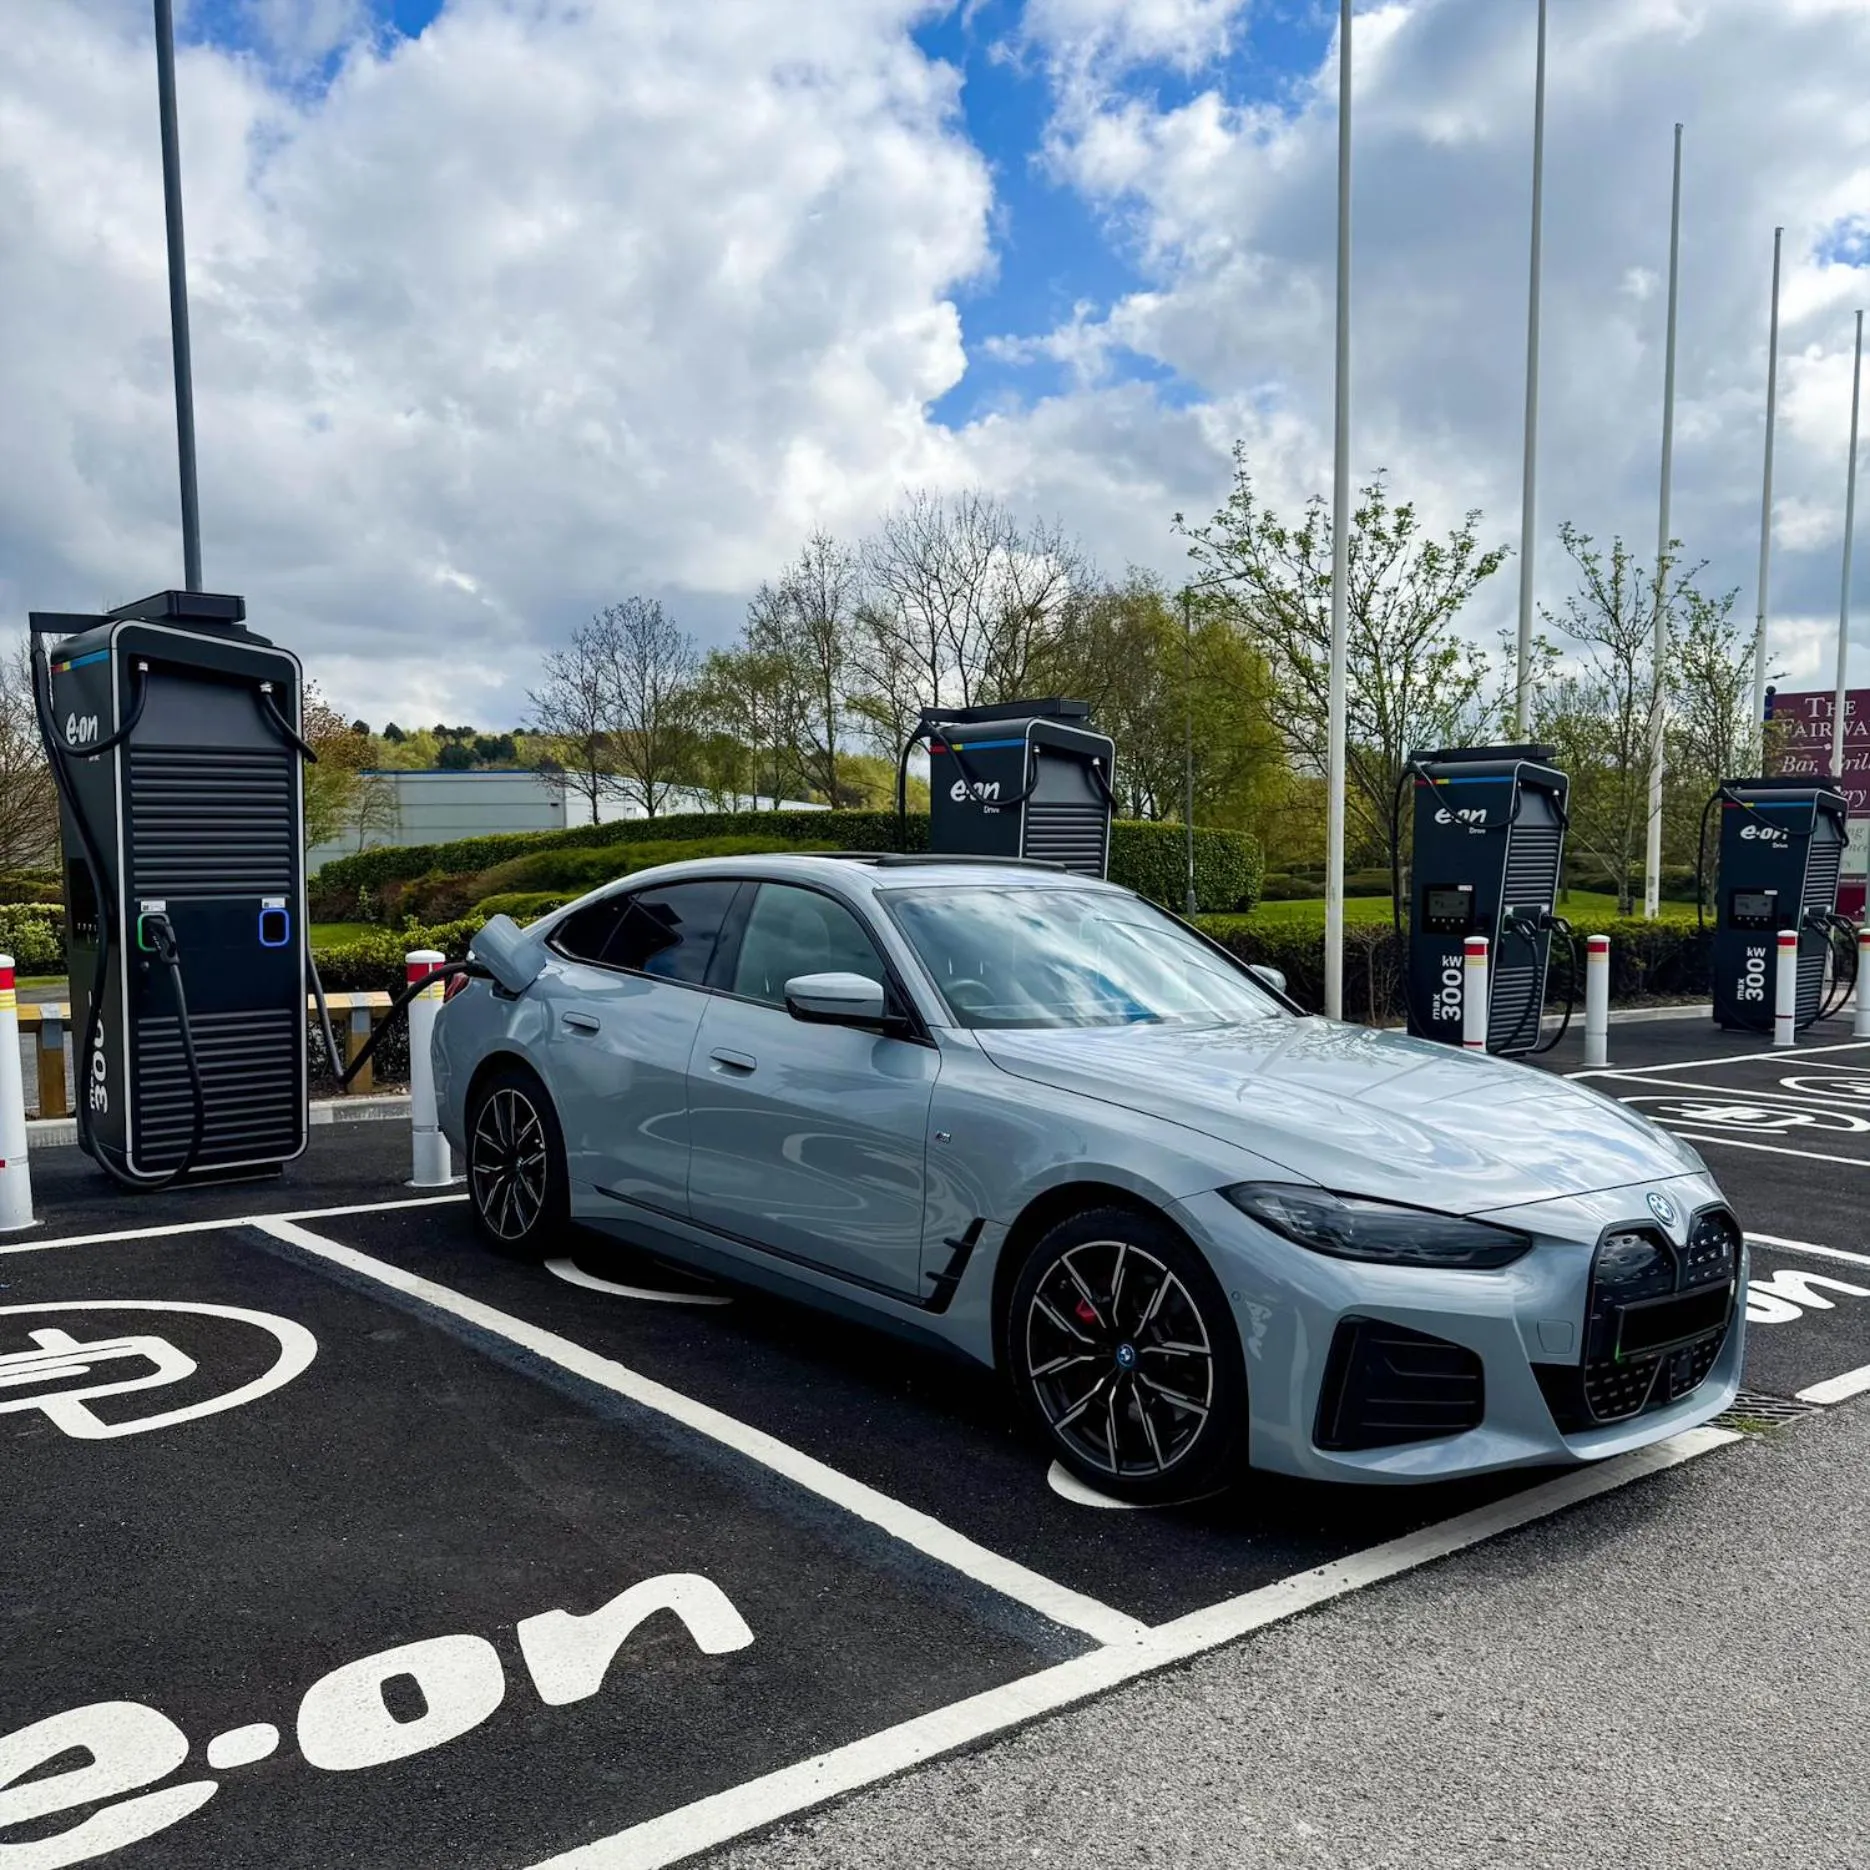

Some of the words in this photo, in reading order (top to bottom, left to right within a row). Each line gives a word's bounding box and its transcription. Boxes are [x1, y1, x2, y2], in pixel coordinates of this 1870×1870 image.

[1781, 755, 1819, 773] Bar,
[1441, 955, 1463, 967] kW
[1746, 946, 1766, 957] kW
[1736, 978, 1745, 1001] max
[1745, 958, 1766, 1001] 300
[1441, 968, 1463, 1021] 300
[1432, 993, 1441, 1020] max
